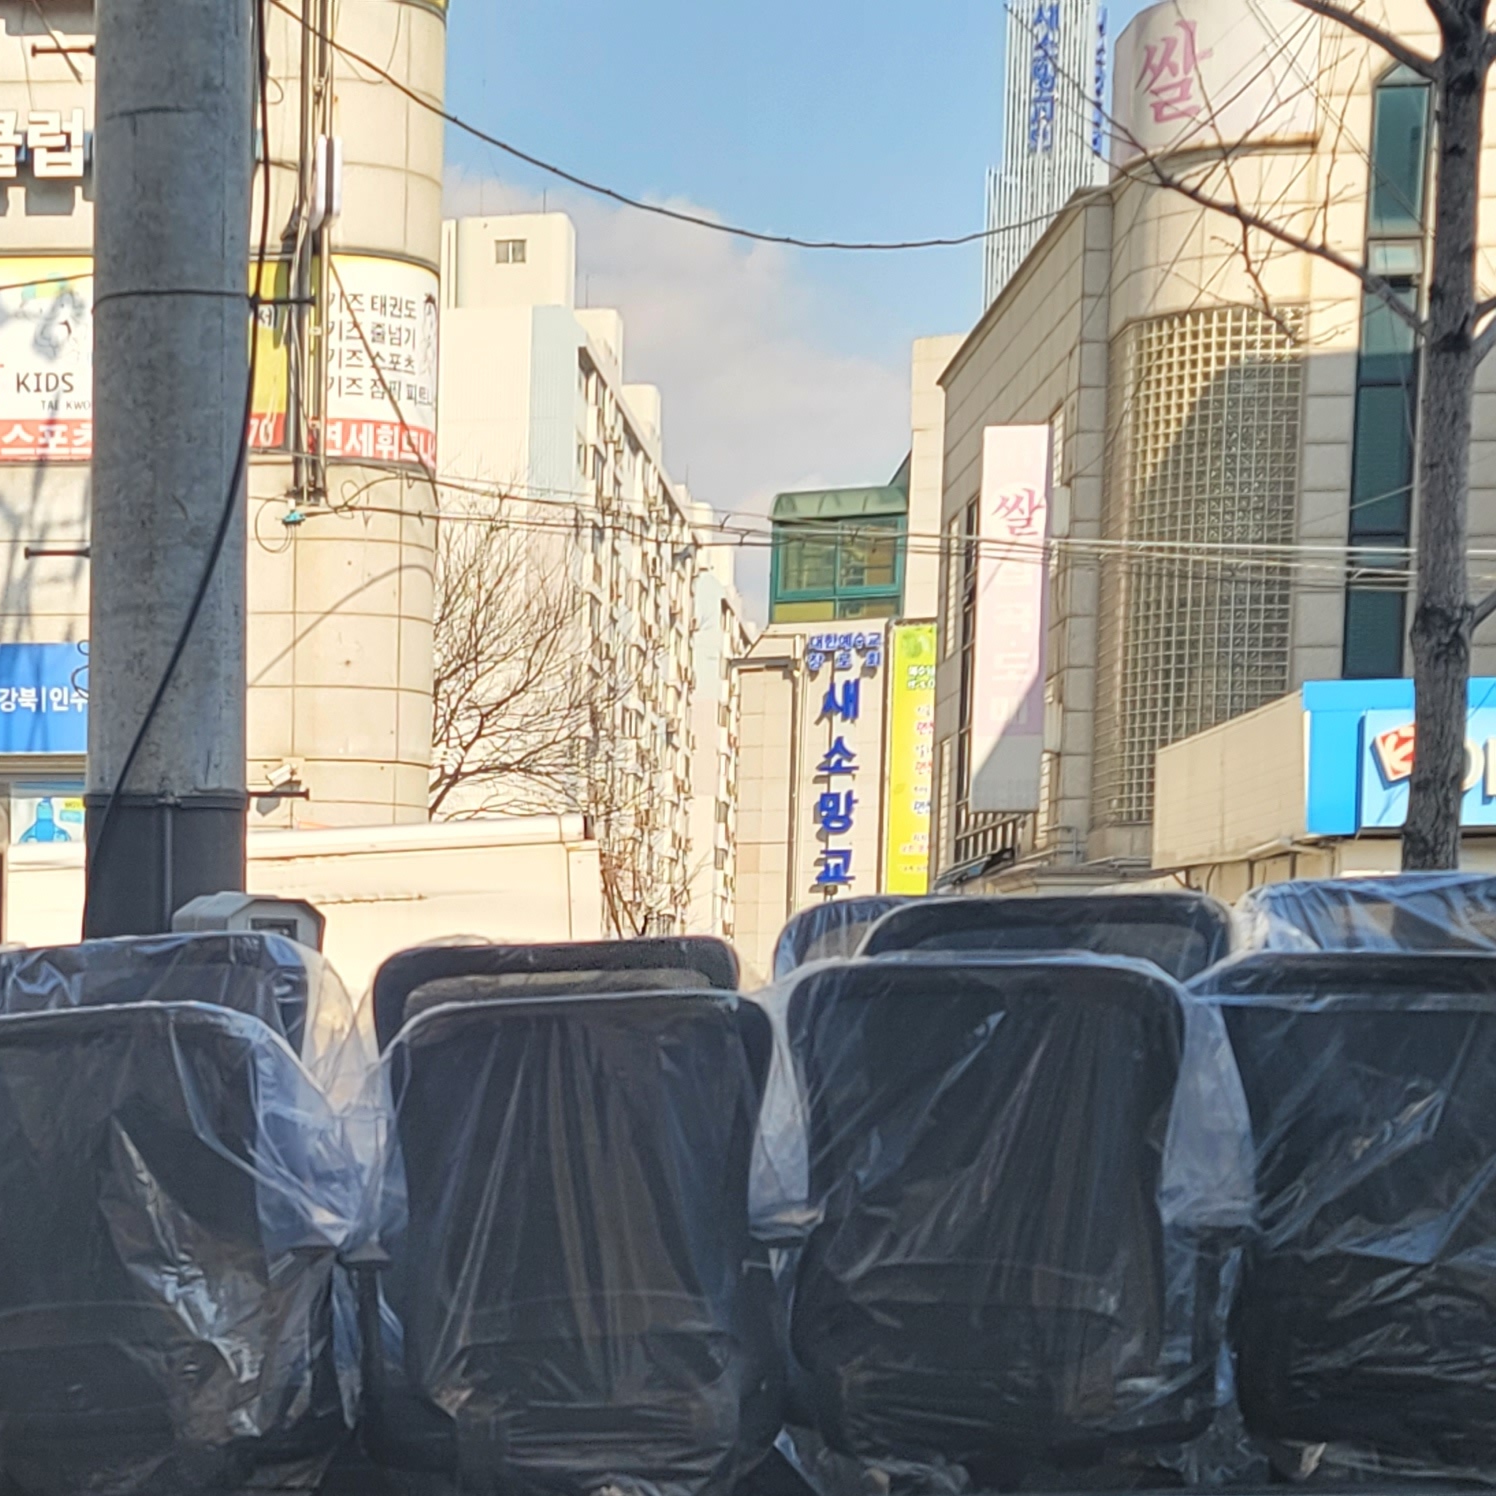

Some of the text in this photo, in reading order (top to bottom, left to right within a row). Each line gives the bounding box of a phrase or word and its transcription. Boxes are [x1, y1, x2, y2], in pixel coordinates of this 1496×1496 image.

[1134, 20, 1213, 123] 쌀
[370, 294, 417, 319] 태권도
[370, 321, 416, 351] 줄넘기
[370, 350, 416, 375] 스포츠
[16, 372, 74, 393] KIDS
[992, 487, 1045, 537] 쌀
